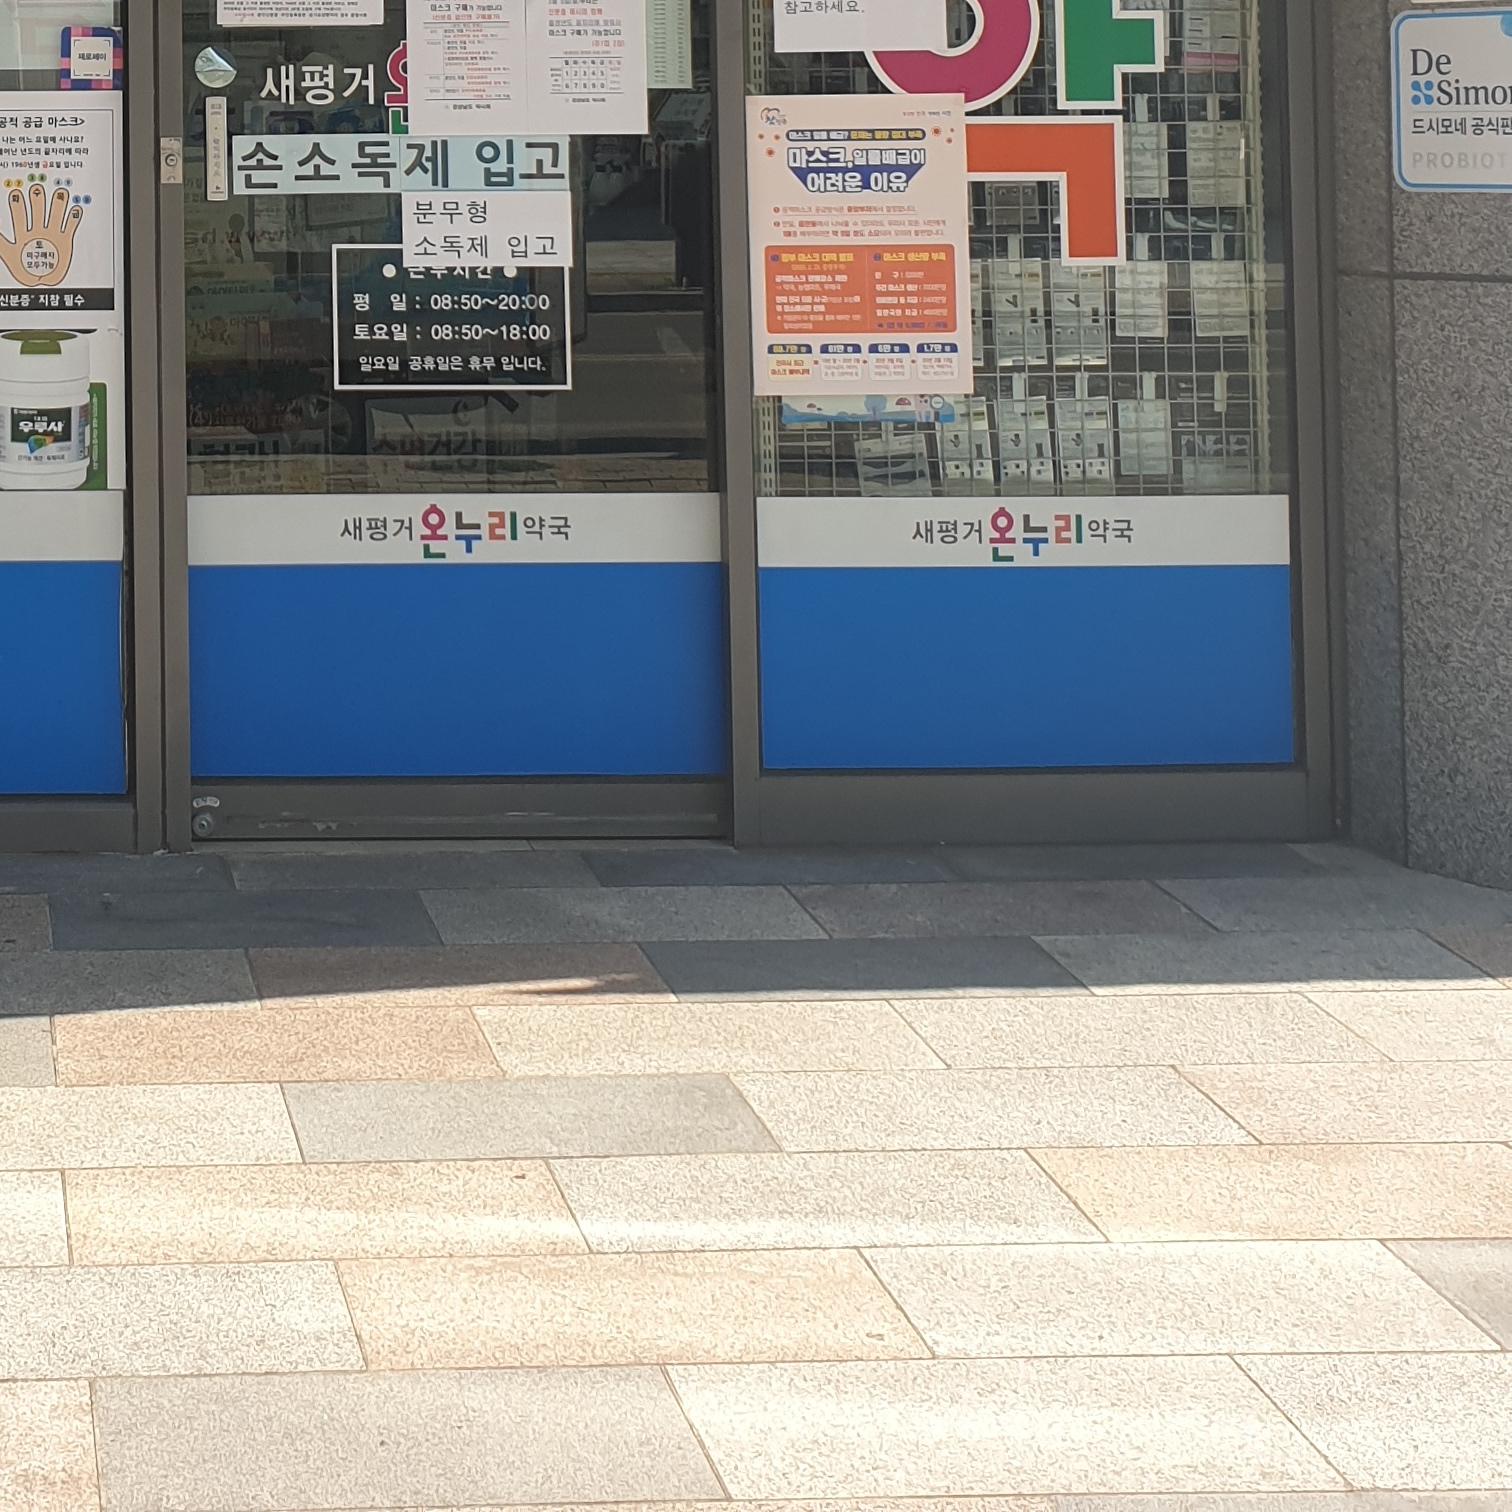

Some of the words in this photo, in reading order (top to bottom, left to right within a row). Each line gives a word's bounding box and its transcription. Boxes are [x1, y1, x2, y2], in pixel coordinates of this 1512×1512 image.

[784, 0, 865, 14] 참고하세요.
[1410, 48, 1451, 76] De
[23, 117, 43, 128] 공급
[1412, 117, 1468, 136] 드시모네
[2, 136, 15, 144] 나는
[236, 138, 448, 189] 손소독제
[474, 138, 566, 189] 입고
[788, 147, 853, 168] 마스크,
[806, 172, 863, 192] 어려운
[870, 172, 909, 192] 이유
[412, 200, 488, 225] 분무형
[412, 234, 489, 259] 소독제
[507, 234, 558, 259] 입고
[39, 294, 60, 307] 지참
[63, 294, 85, 307] 필수
[353, 293, 370, 311] 평
[430, 293, 550, 311] 08:50~20:00
[353, 324, 407, 341] 토요일
[430, 324, 550, 341] 08:50~18:00
[359, 356, 400, 371] 일요일
[408, 356, 463, 371] 공휴일은
[468, 356, 496, 371] 휴무
[501, 356, 546, 371] 입니다.
[18, 420, 64, 433] 우루사
